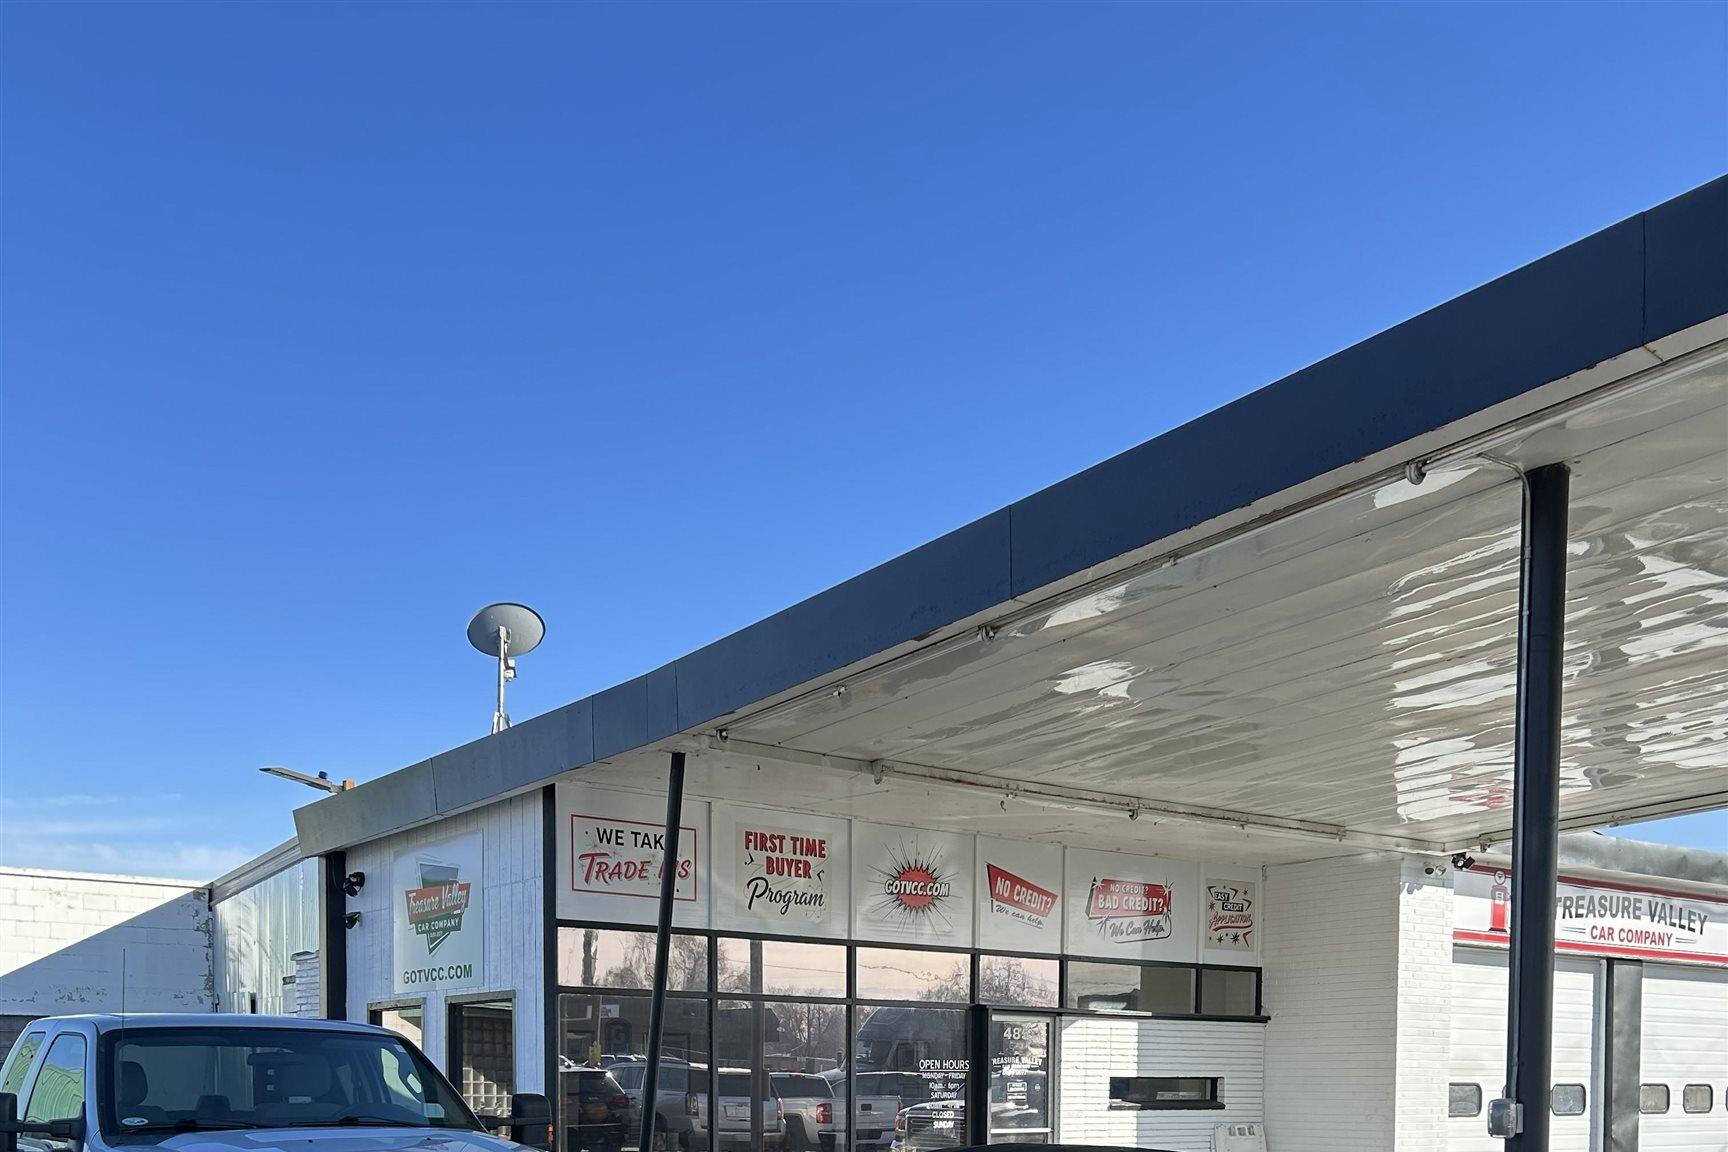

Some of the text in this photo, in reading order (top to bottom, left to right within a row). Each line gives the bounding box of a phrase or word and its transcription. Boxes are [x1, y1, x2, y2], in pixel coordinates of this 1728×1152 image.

[596, 827, 666, 851] WE TAK
[744, 831, 826, 859] FIRST TIME
[765, 855, 812, 879] BUYER
[746, 876, 825, 915] Program
[884, 878, 950, 898] GOTVCC.COM
[995, 876, 1053, 914] NO CREDIT?
[1109, 883, 1150, 895] NO CREDIT?
[1214, 892, 1229, 901] EASY
[408, 884, 467, 916] Treasure Valley
[1098, 894, 1164, 912] BAD CREDIT?
[1223, 902, 1243, 911] CREDIT
[417, 917, 460, 932] CAR COMPANY
[1011, 911, 1026, 921] can
[1647, 899, 1708, 936] VALLEY
[1590, 925, 1673, 947] CAR COMPANY
[403, 963, 473, 985] GOTVCC.COM
[919, 1059, 970, 1070] OPEN HOURS
[930, 1091, 958, 1099] SATURDAY
[931, 1110, 955, 1119] CLOSED
[932, 1120, 955, 1129] SUNDAY
